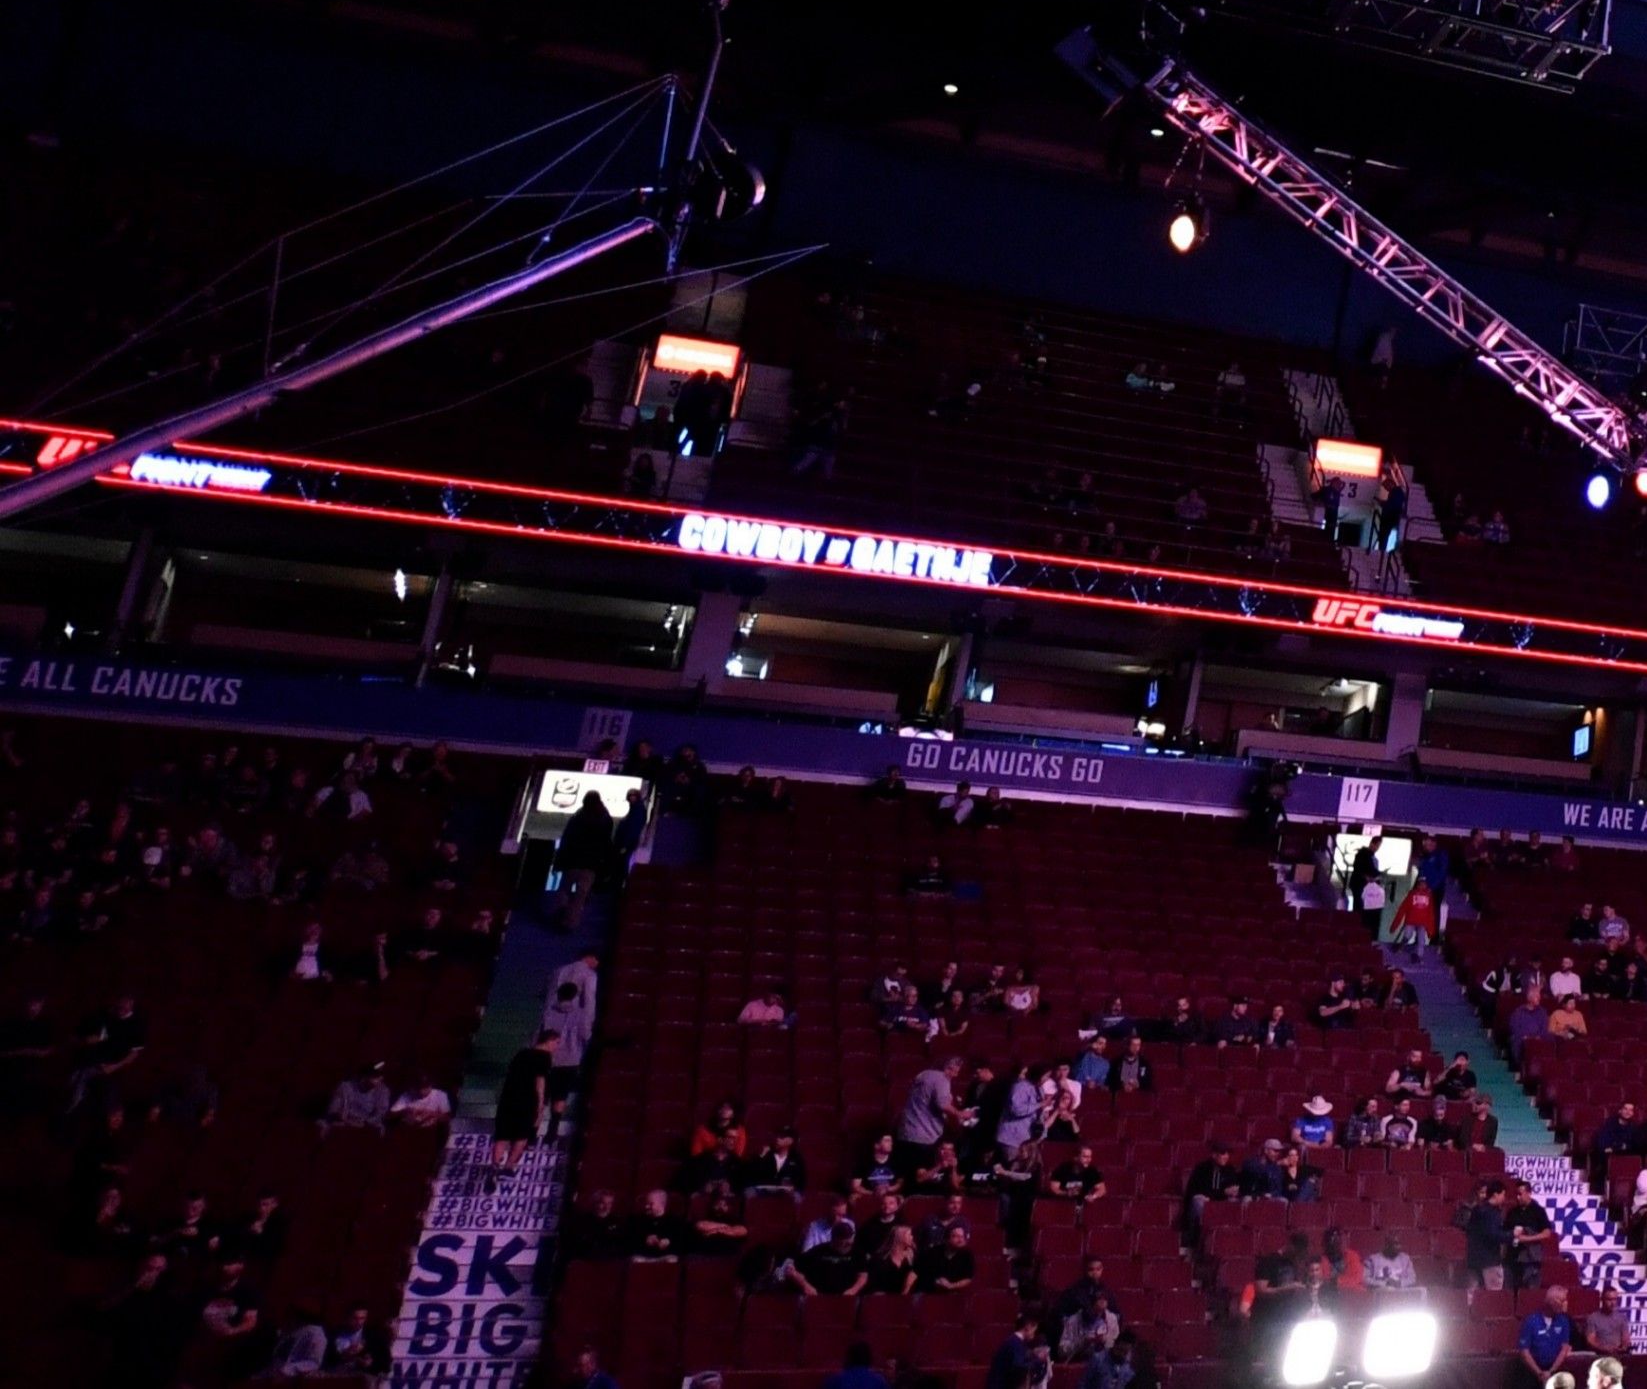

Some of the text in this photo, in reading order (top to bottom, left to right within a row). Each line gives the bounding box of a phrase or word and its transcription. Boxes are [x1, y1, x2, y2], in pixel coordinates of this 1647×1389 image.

[678, 512, 825, 564] COWBOY
[850, 535, 993, 587] GAETHJE
[1312, 597, 1380, 628] UFC
[22, 659, 78, 694] ALL
[91, 665, 244, 707] CANUCKS
[587, 713, 619, 736] 116
[906, 741, 1105, 785] GO CANUCKS GO
[1345, 783, 1374, 803] 117
[1562, 800, 1592, 828] WE
[1597, 804, 1636, 831] ARE
[1504, 1156, 1566, 1169] BIGWHITE
[1512, 1169, 1577, 1182] BIGWHITE
[436, 1196, 558, 1213] #BIGWHITE
[431, 1212, 555, 1229] #BIGWHITE
[1545, 1198, 1628, 1245] KI
[409, 1233, 554, 1298] SKI
[407, 1302, 529, 1357] BIG
